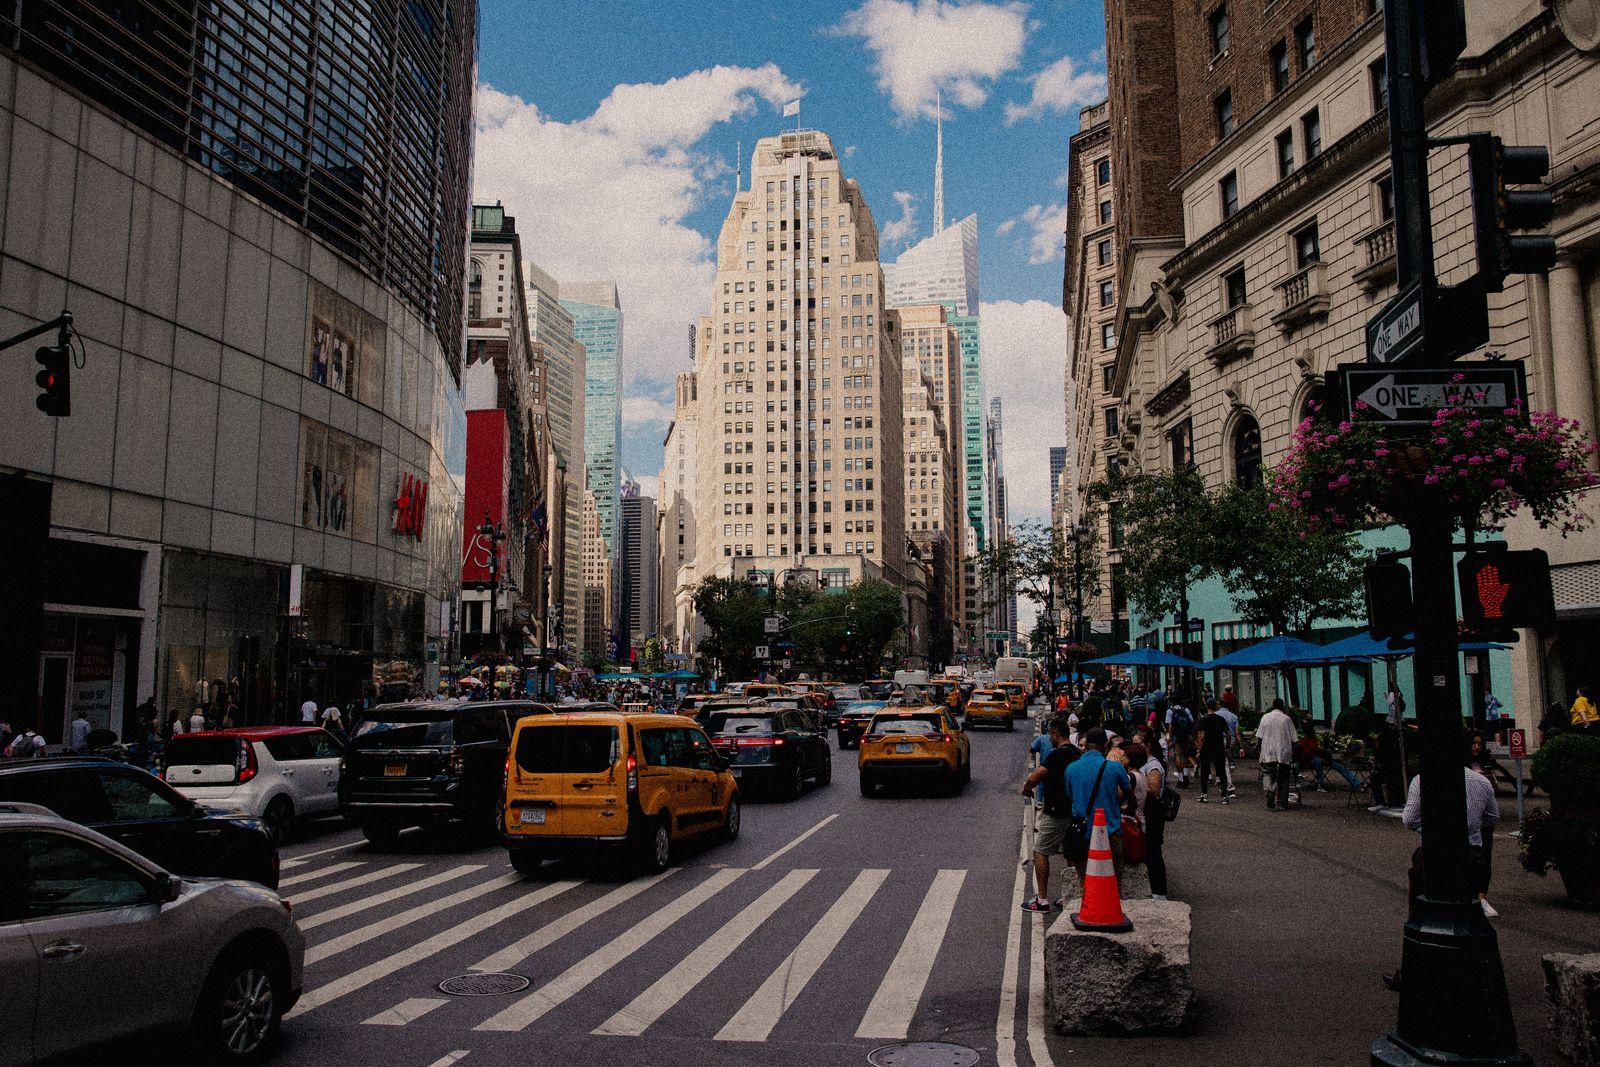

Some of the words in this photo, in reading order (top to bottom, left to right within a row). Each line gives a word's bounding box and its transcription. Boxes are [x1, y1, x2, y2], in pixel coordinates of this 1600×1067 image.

[1377, 328, 1392, 354] ONE
[1397, 306, 1415, 338] WAY
[1375, 385, 1421, 407] ONE
